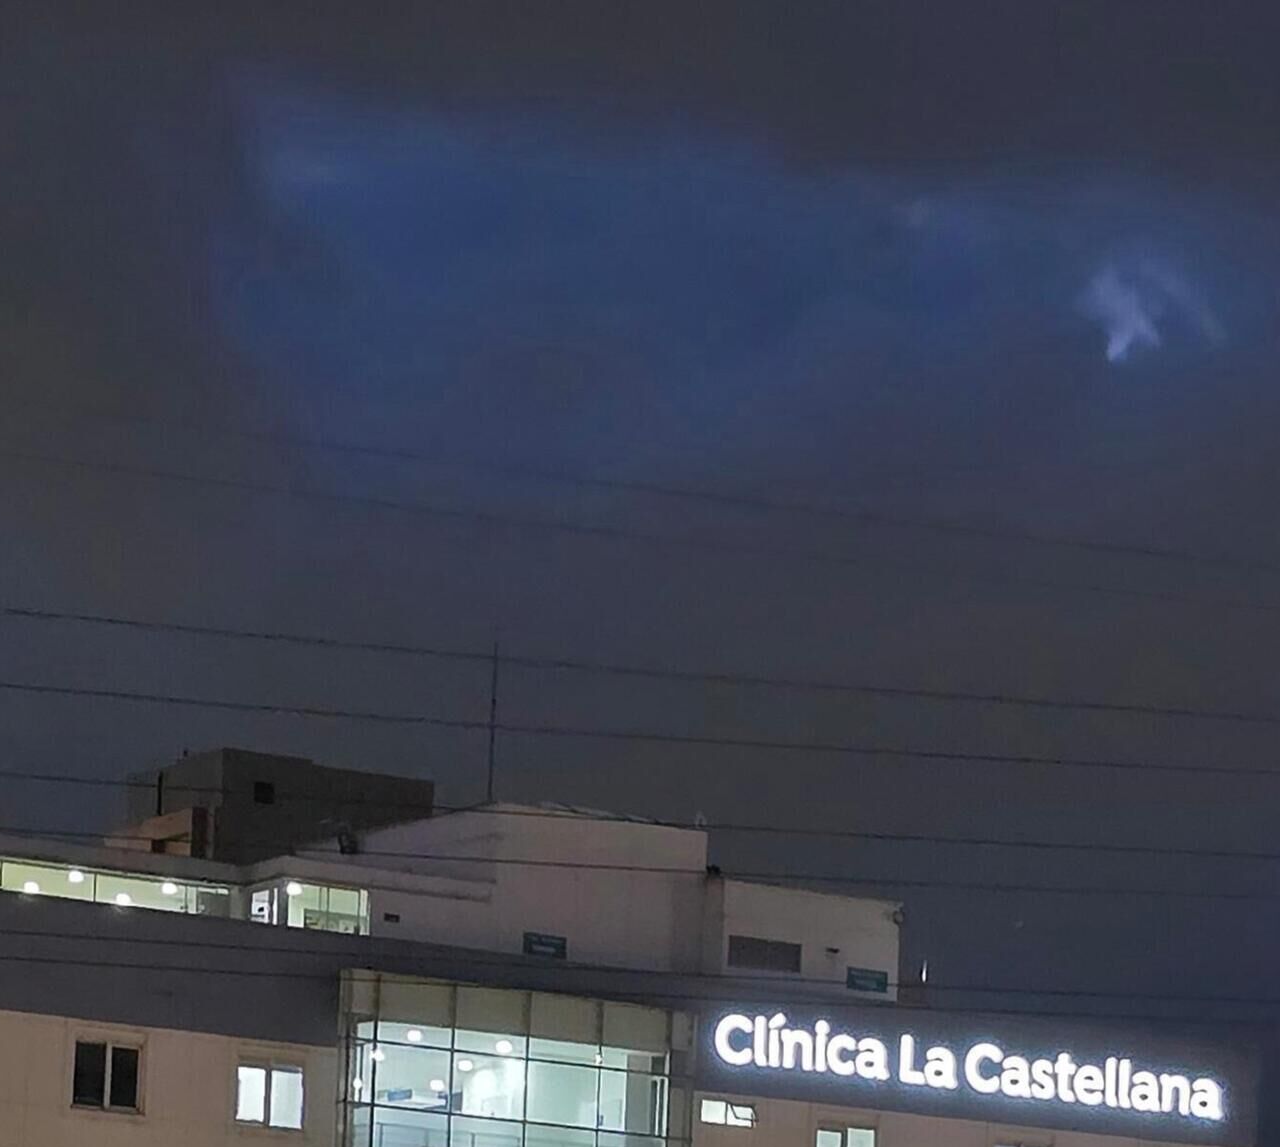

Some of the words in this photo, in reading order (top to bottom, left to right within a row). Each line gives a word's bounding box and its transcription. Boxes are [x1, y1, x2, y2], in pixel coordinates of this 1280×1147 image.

[714, 1012, 890, 1082] Clínica
[899, 1033, 958, 1090] La
[964, 1043, 1224, 1121] Castellana
